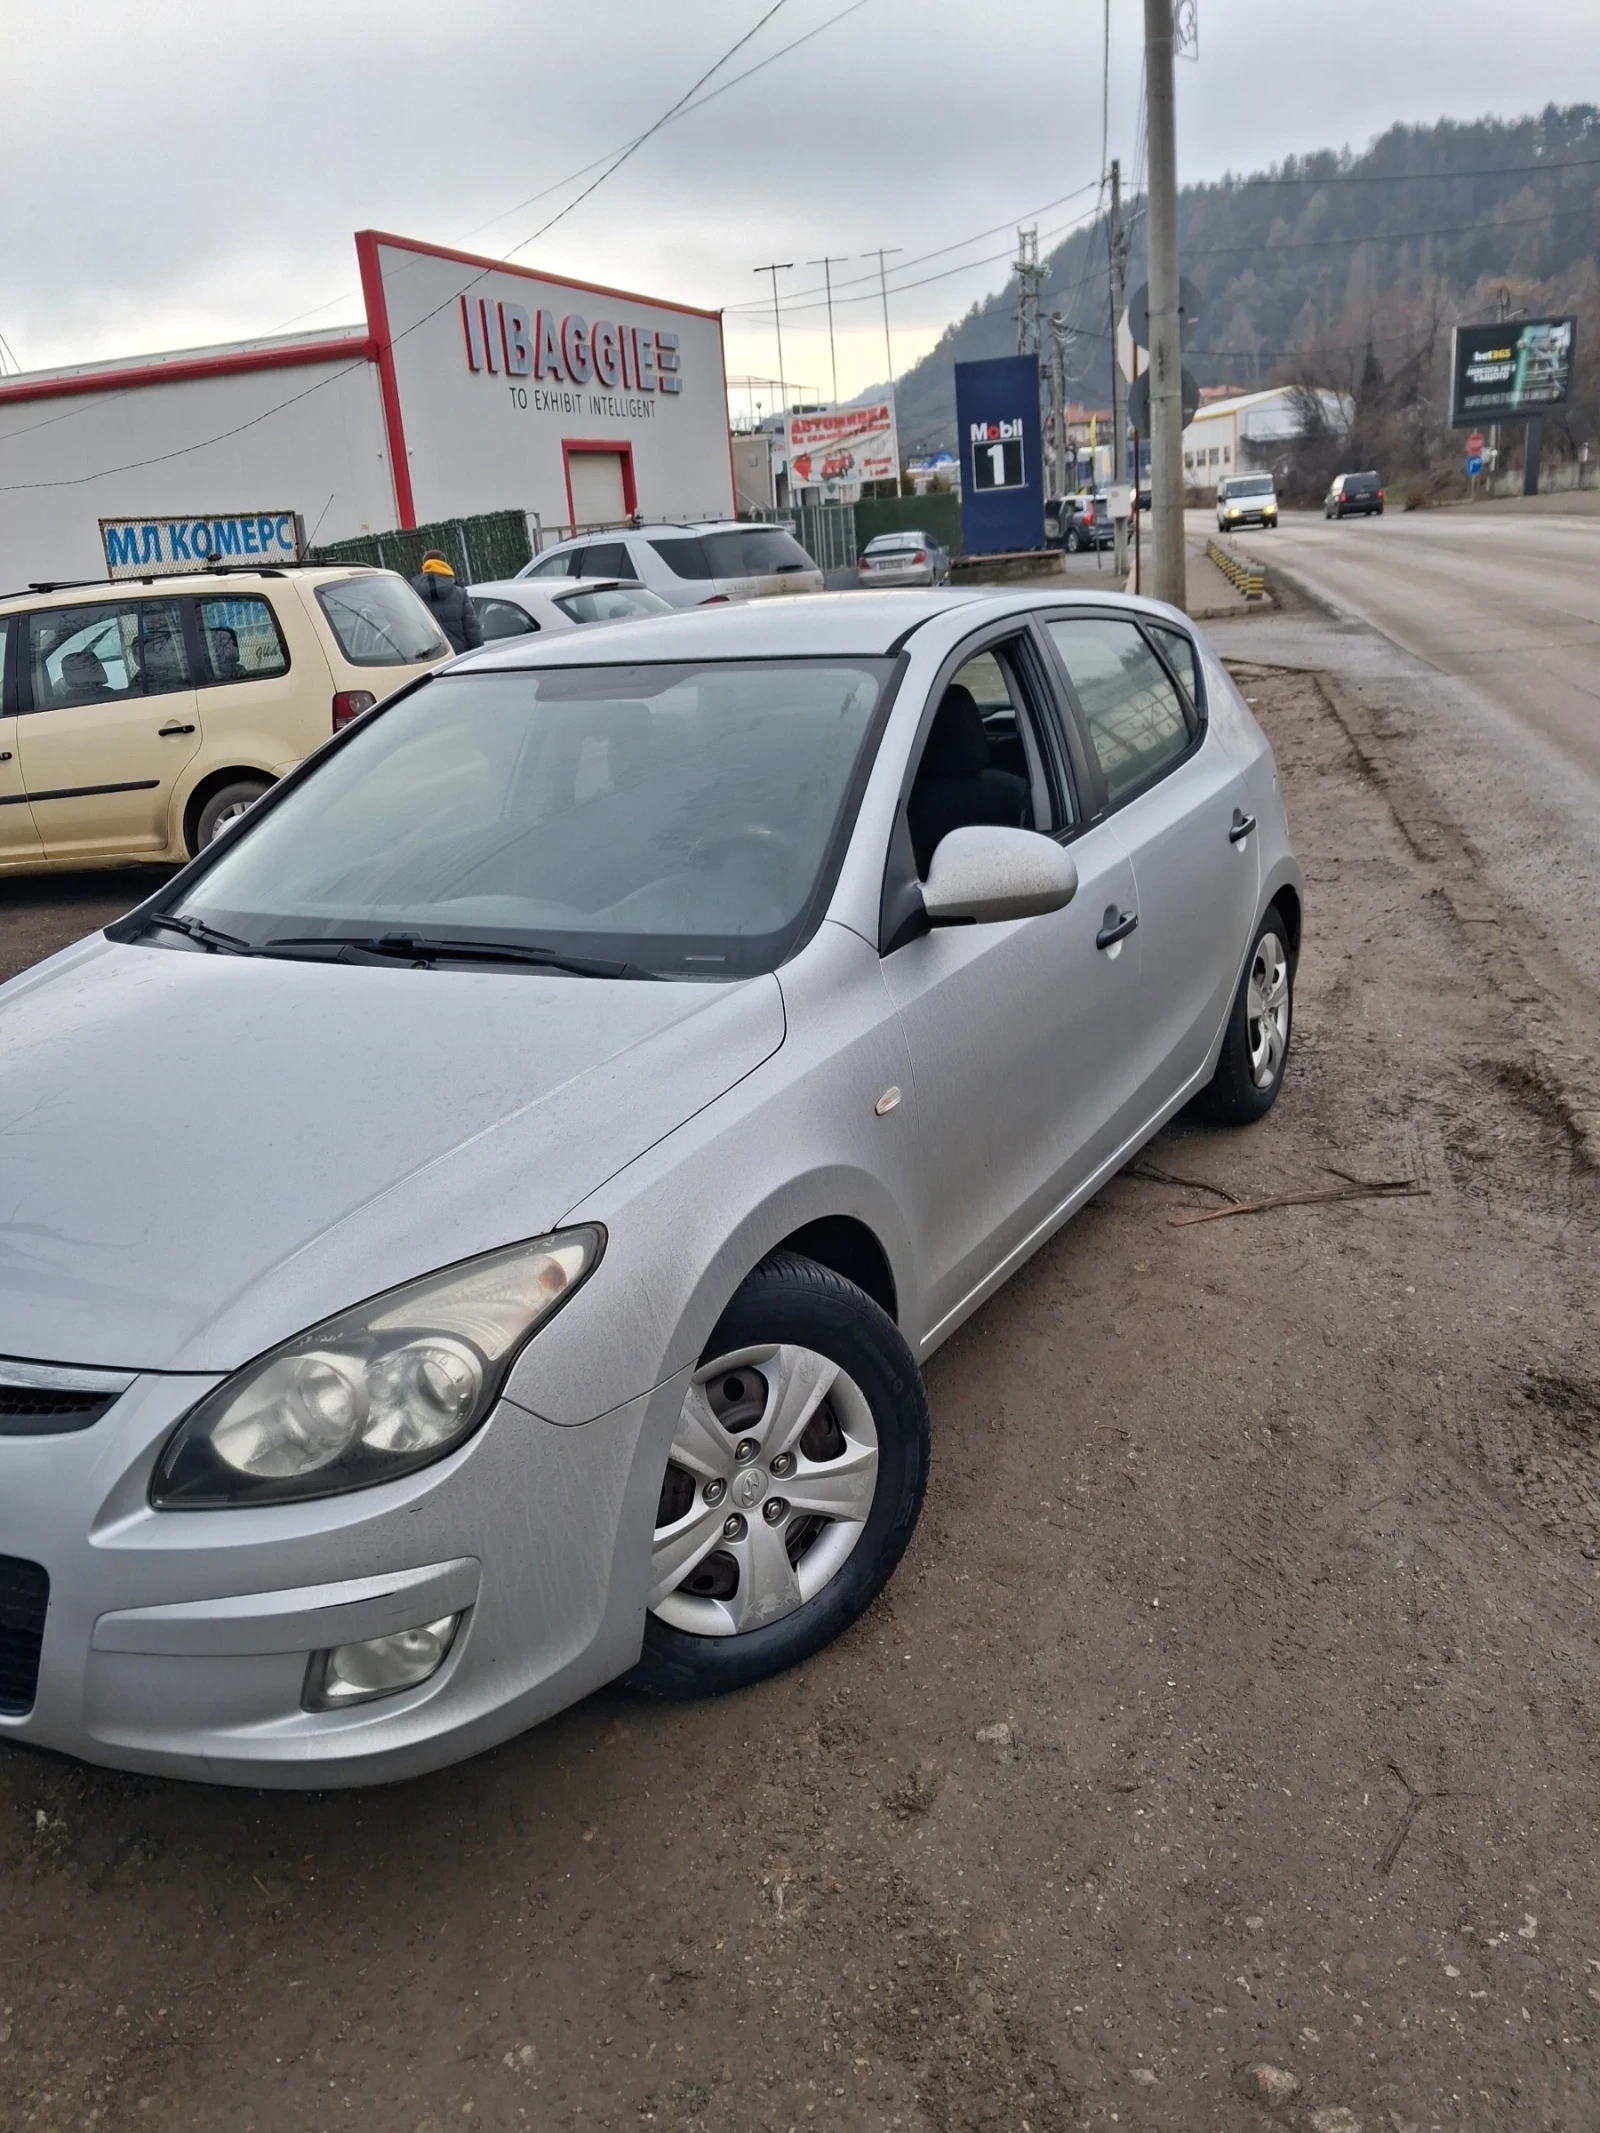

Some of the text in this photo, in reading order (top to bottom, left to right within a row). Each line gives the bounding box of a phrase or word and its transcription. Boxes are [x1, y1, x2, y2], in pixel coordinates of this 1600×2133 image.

[509, 386, 656, 418] TO EXHIBIT INTELLIGENT
[970, 418, 1023, 441] Mobil
[986, 444, 1005, 486] 1
[107, 517, 294, 567] МЛ КОМЕРС
